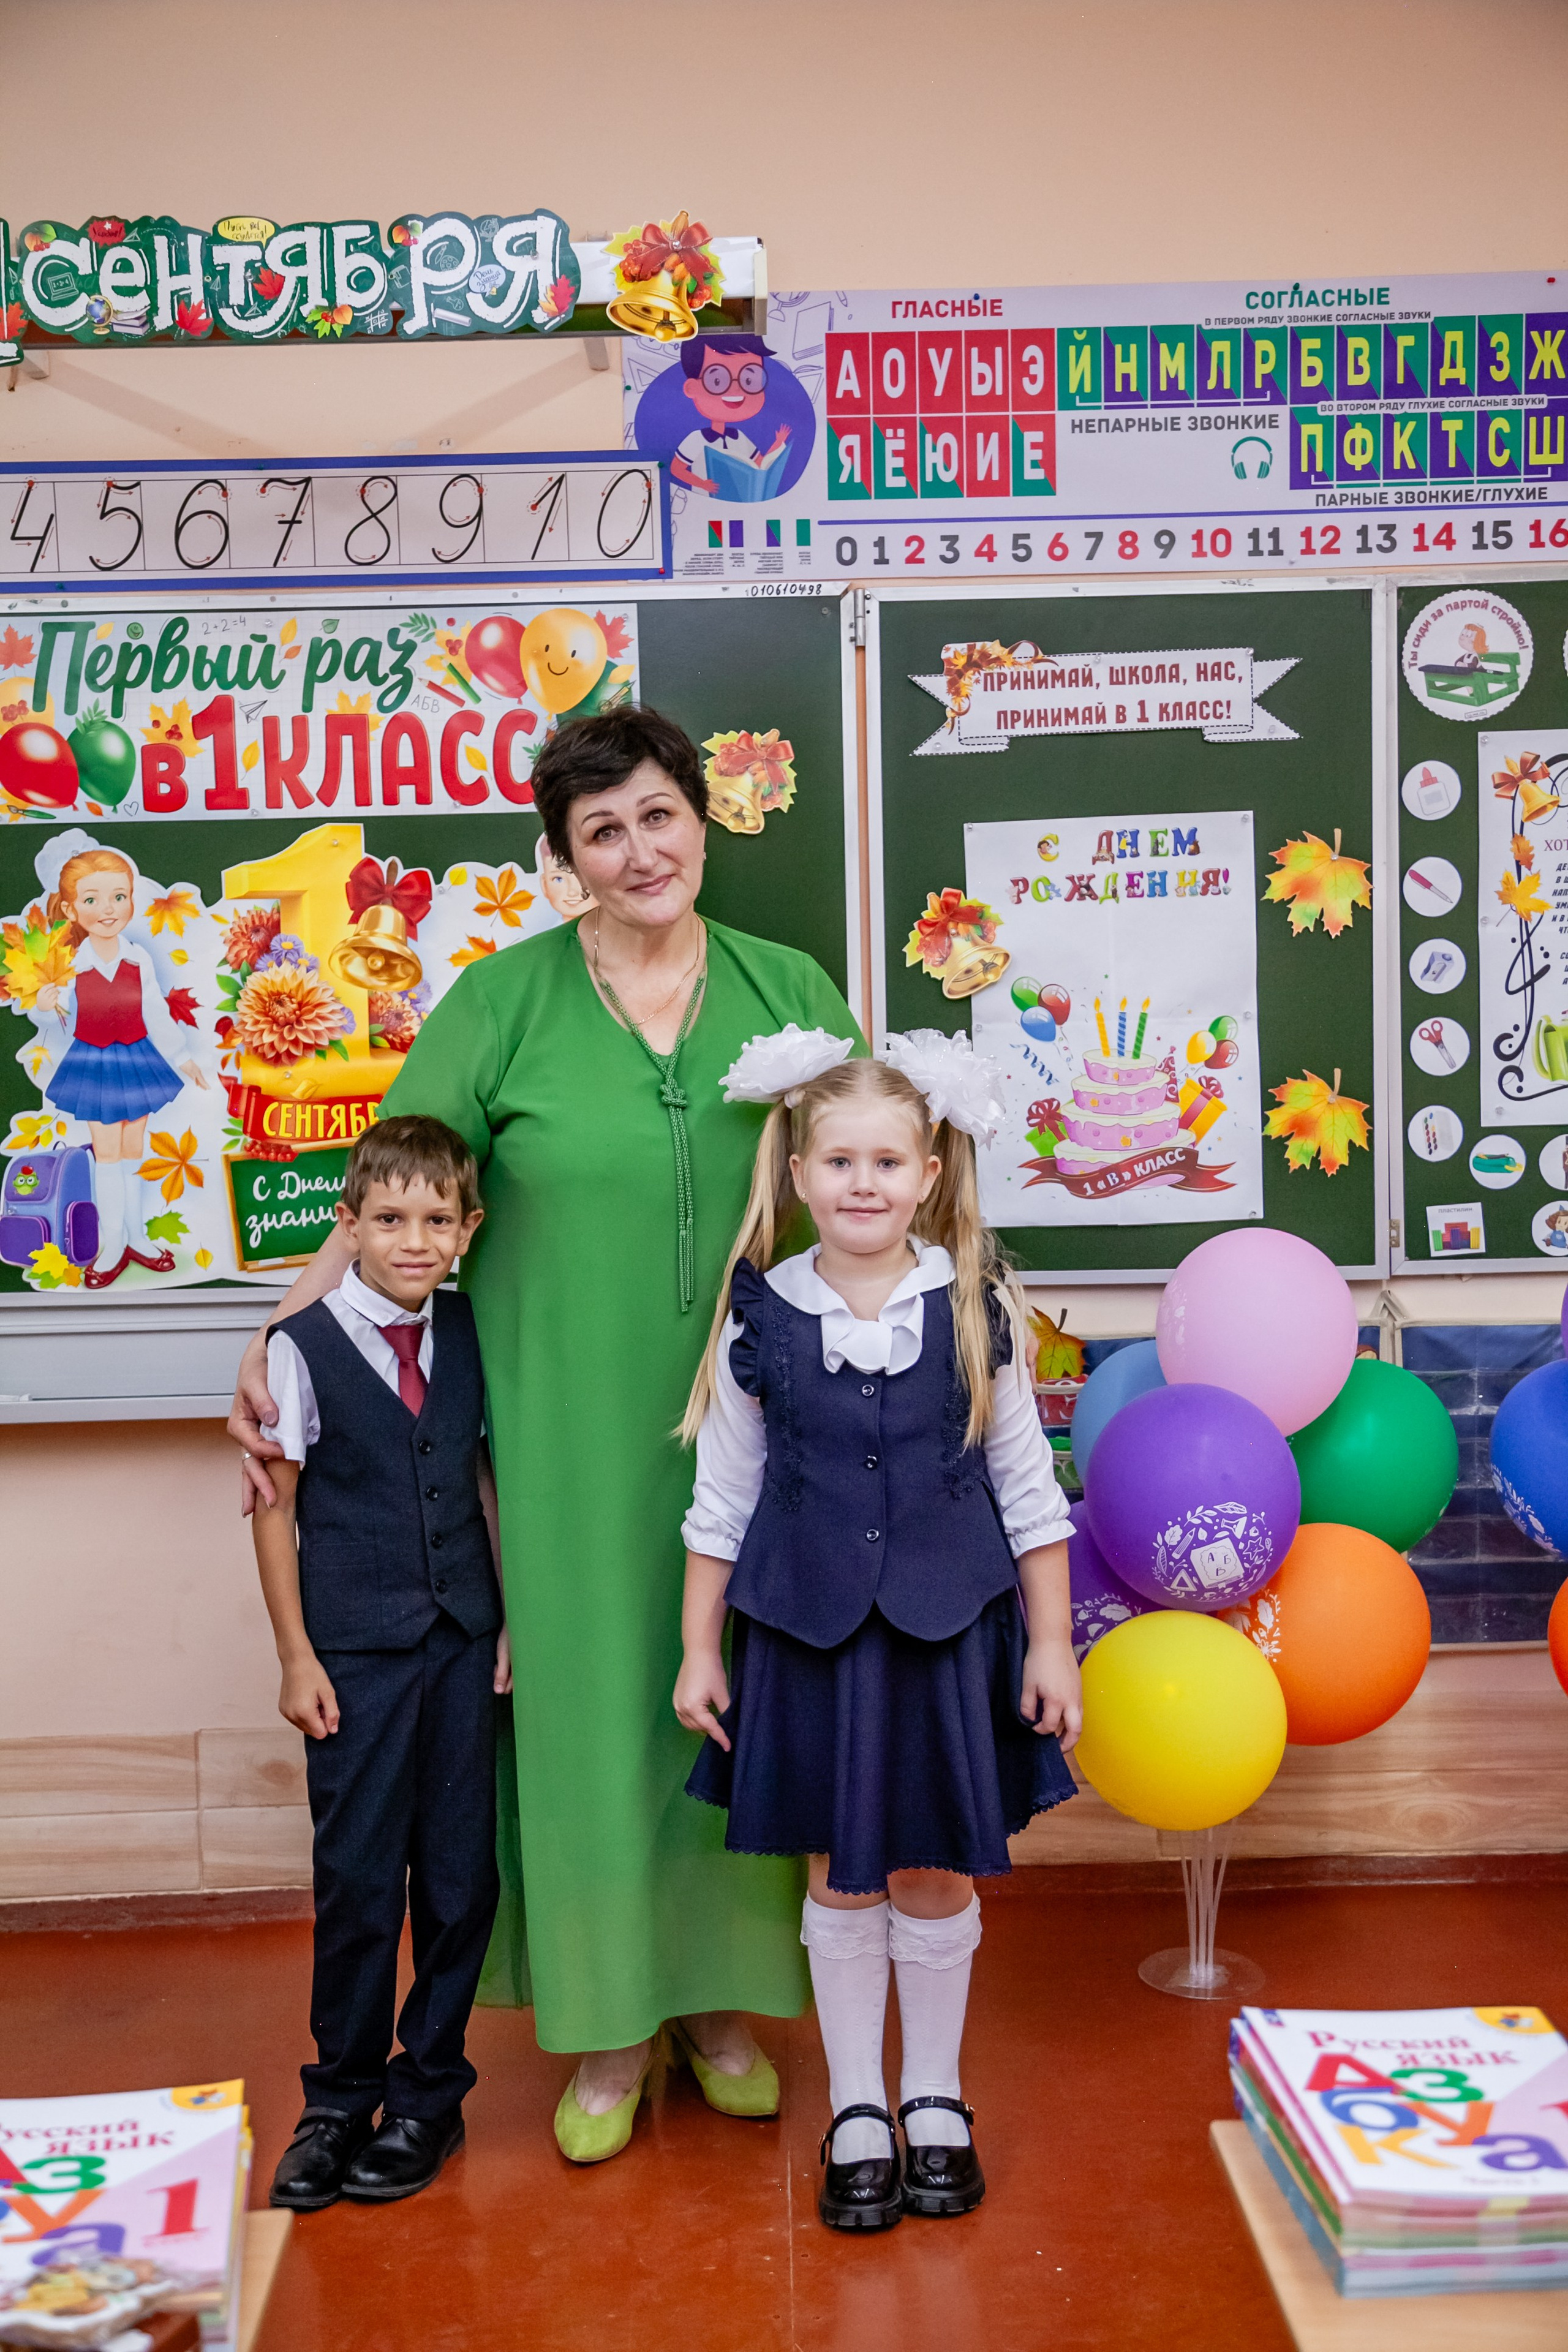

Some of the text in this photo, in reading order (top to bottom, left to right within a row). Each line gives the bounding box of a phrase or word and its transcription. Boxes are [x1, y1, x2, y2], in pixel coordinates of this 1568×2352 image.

[891, 299, 1003, 318] ГЛАСНЫЕ
[1245, 287, 1390, 309] СОГЛАСНЫЕ
[1215, 317, 1254, 325] ПЕРВОМ
[1258, 316, 1284, 325] РЯДУ
[1287, 314, 1332, 323] ЗВОНКИЕ
[1336, 312, 1395, 322] СОГЛАСНЫЕ
[1398, 311, 1431, 320] ЗВУКИ
[835, 330, 1566, 398] А О У Ы Э Й Н М Л Р Б В Г Д З Ж
[1379, 402, 1405, 411] РЯДУ
[1409, 401, 1445, 409] ГЛУХИЕ
[1449, 399, 1508, 408] СОГЛАСНЫЕ
[1512, 398, 1544, 406] ЗВУКИ
[1071, 413, 1279, 434] НЕПАРНЫЕ ЗВОНКИЕ
[839, 416, 1564, 488] Я Ё Ю И Е П Ф К Т С Ш
[1315, 487, 1548, 507] ПАРНЫЕ ЗВОНКИЕ/ГЛУХИЕ
[10, 480, 55, 572] 4
[88, 480, 143, 571] 5
[174, 479, 229, 569] 6
[260, 476, 312, 567] 7
[344, 475, 398, 565] 8
[432, 474, 483, 564] 9
[835, 536, 857, 566] 0
[873, 536, 889, 565] 1
[905, 535, 925, 564] 2
[939, 534, 960, 564] 3
[974, 533, 997, 563] 4
[1011, 533, 1032, 562] 5
[1047, 532, 1069, 562] 6
[1084, 531, 1104, 560] 7
[1118, 530, 1139, 560] 8
[1154, 529, 1175, 559] 9
[1191, 528, 1232, 558] 10
[1248, 527, 1284, 557] 11
[1300, 525, 1341, 556] 12
[1356, 524, 1397, 554] 13
[1413, 522, 1456, 552] 14
[1472, 520, 1513, 551] 15
[1529, 518, 1568, 548] 16
[1409, 599, 1529, 669] Ты сиди за партой стройно!
[32, 616, 417, 718] Первый раз
[983, 661, 1243, 692] ПРИНИМАЙ, ШКОЛА, НАС,
[411, 693, 440, 713] АБВ
[997, 699, 1232, 729] ПРИНИМАЙ В 1 КЛАСС!
[192, 695, 249, 810] 1
[262, 708, 537, 809] КЛАСС
[1037, 827, 1200, 865] С ДНЕМ
[1006, 868, 1231, 905] РОЖДЕНИЯ!
[263, 1102, 381, 1137] СЕНТЯБР
[1083, 1182, 1095, 1196] 1
[1133, 1148, 1186, 1177] КЛАСС
[246, 1206, 338, 1248] знани
[1306, 2031, 1472, 2051] Русский
[0, 2119, 139, 2141] усский
[142, 2177, 209, 2247] 1
